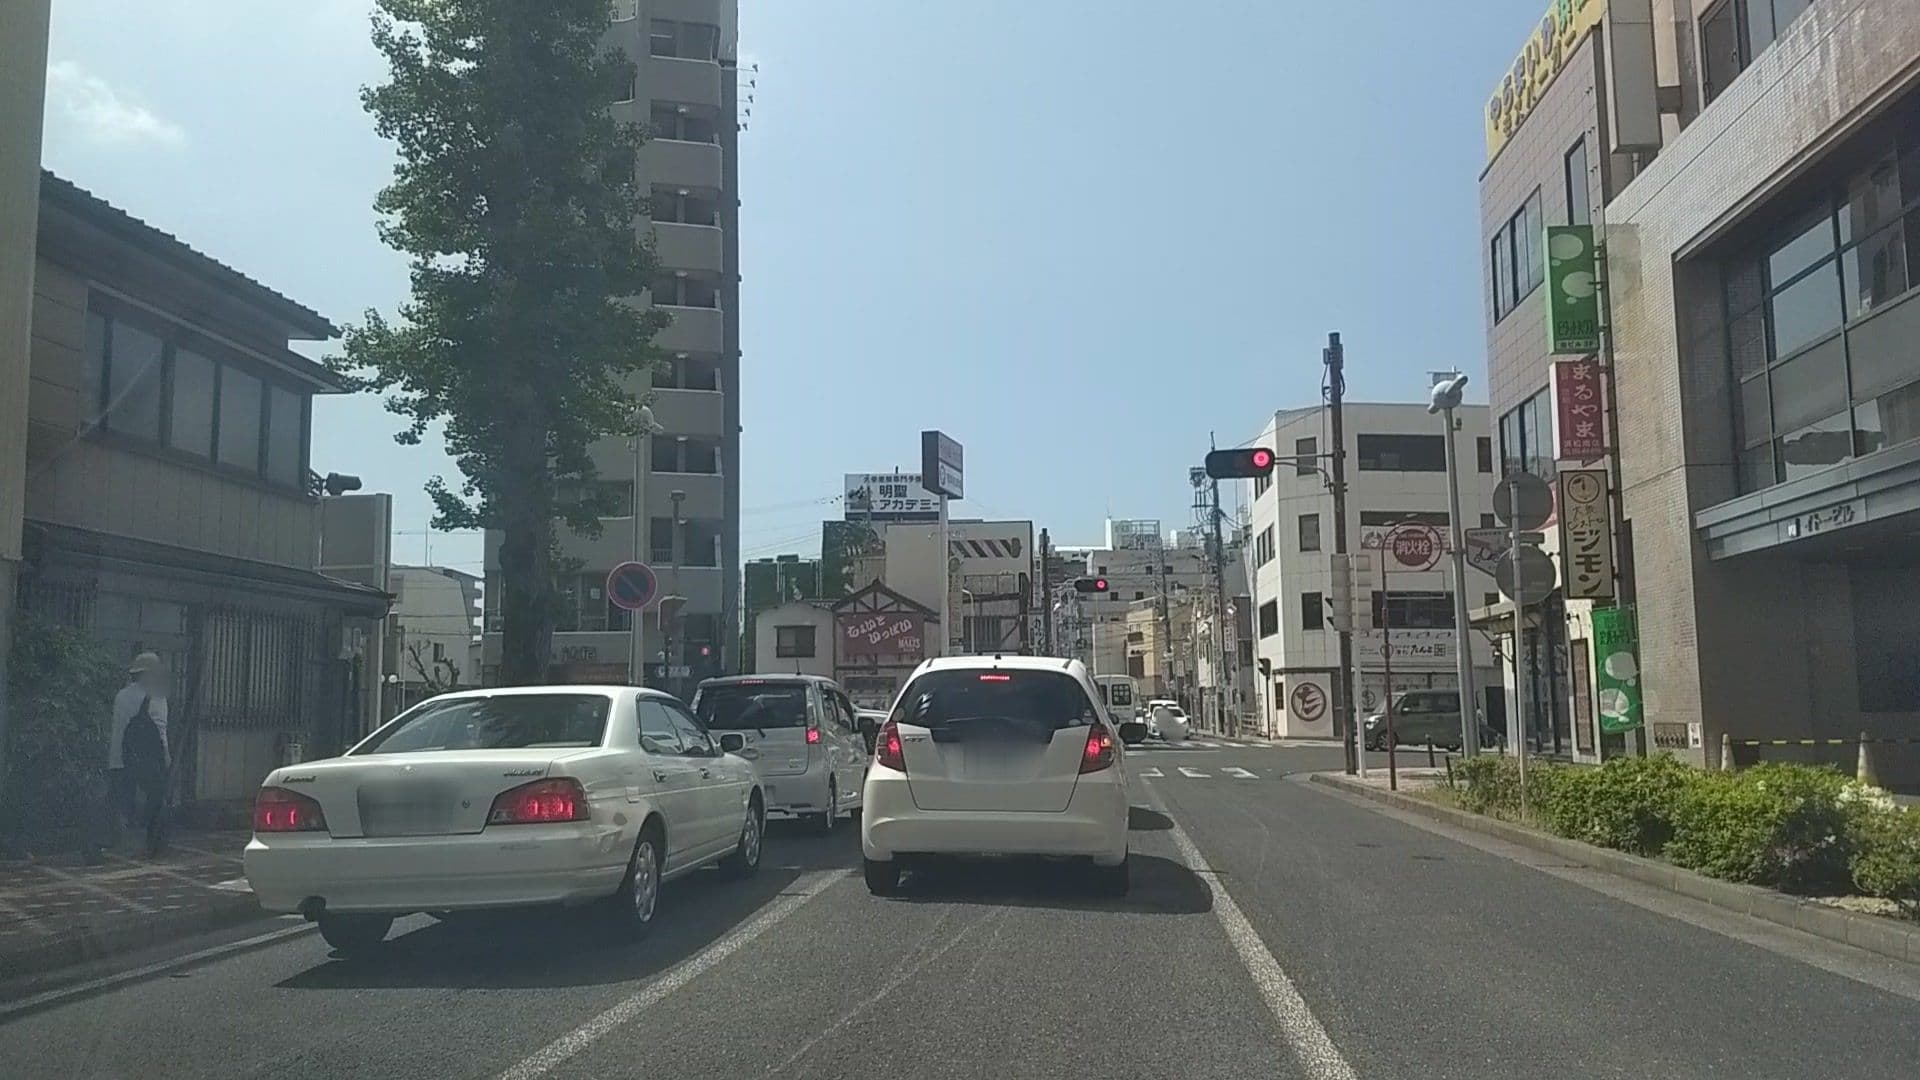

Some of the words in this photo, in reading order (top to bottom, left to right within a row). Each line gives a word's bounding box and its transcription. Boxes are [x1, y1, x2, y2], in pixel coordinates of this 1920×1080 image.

[1571, 363, 1598, 438] まるやま
[879, 484, 908, 499] 明聖
[879, 499, 940, 511] アカデミー
[1396, 539, 1430, 555] 消火栓
[1573, 529, 1603, 594] ジモン
[847, 615, 886, 639] ちょいと
[868, 619, 913, 645] いっぱい
